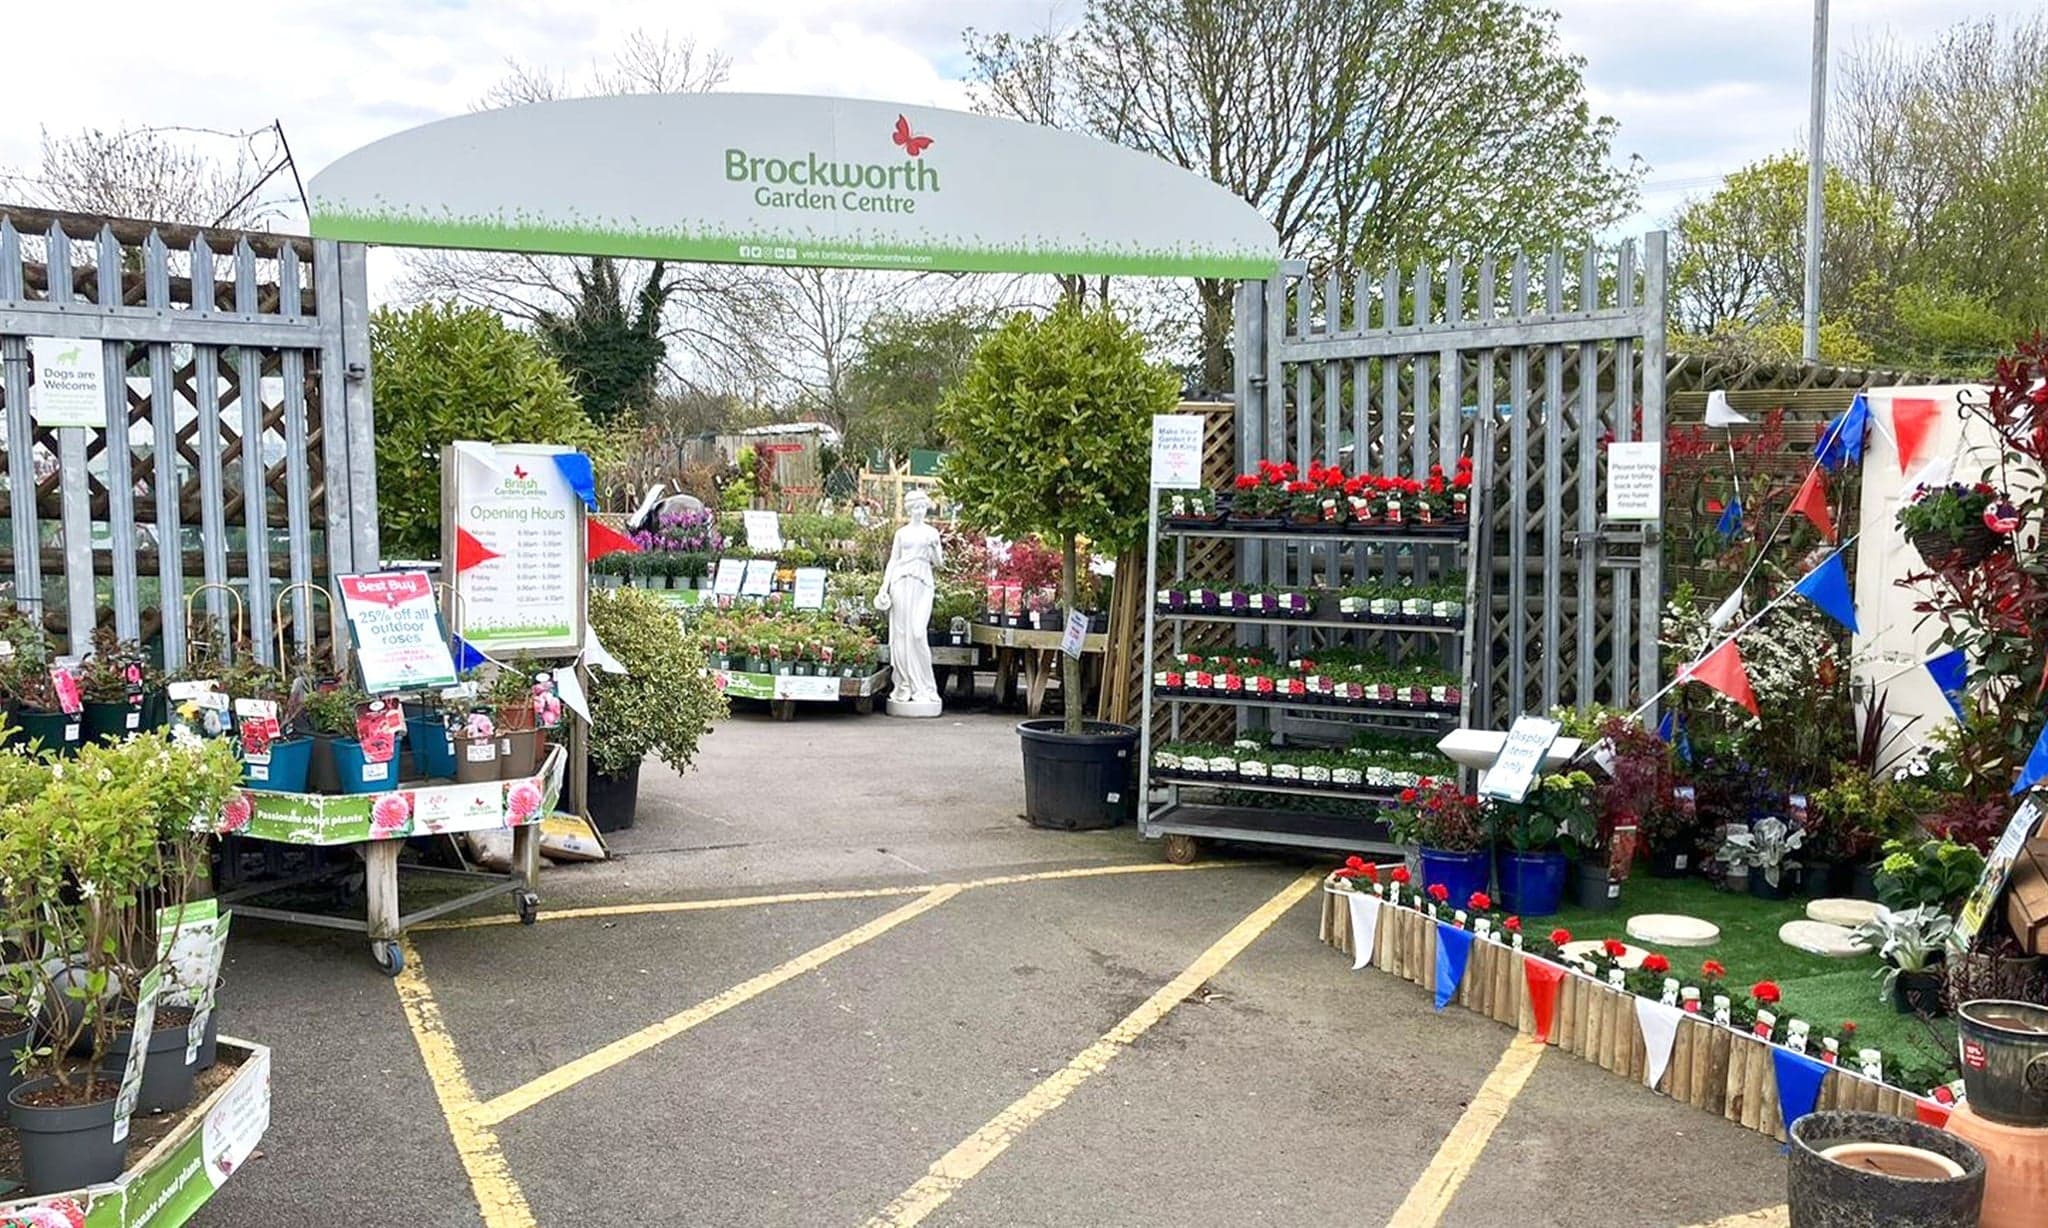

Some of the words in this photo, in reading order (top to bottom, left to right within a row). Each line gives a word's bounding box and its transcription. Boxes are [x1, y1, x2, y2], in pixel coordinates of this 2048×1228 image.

[725, 149, 940, 192] Brockworth
[755, 187, 836, 210] Garden
[842, 191, 915, 214] Centre
[802, 251, 820, 261] visit
[821, 250, 933, 265] britishgardencentres.com
[44, 367, 74, 380] Dogs
[77, 371, 96, 380] are
[43, 379, 97, 391] Welcome
[1636, 463, 1657, 471] bring
[504, 478, 538, 489] British
[494, 487, 521, 496] Garden
[522, 488, 548, 496] Centres
[470, 504, 528, 523] Opening
[531, 506, 566, 520] Hours
[356, 581, 386, 593] Best
[388, 579, 417, 592] Buy
[359, 609, 391, 624] 25%
[393, 608, 411, 621] off
[415, 608, 430, 620] all
[370, 622, 425, 635] outdoor
[382, 634, 421, 645] roses
[1509, 729, 1547, 746] Display
[1509, 746, 1535, 758] items
[1502, 761, 1523, 774] only
[256, 809, 302, 823] Passionate
[330, 814, 363, 827] plants
[178, 1156, 202, 1191] plants
